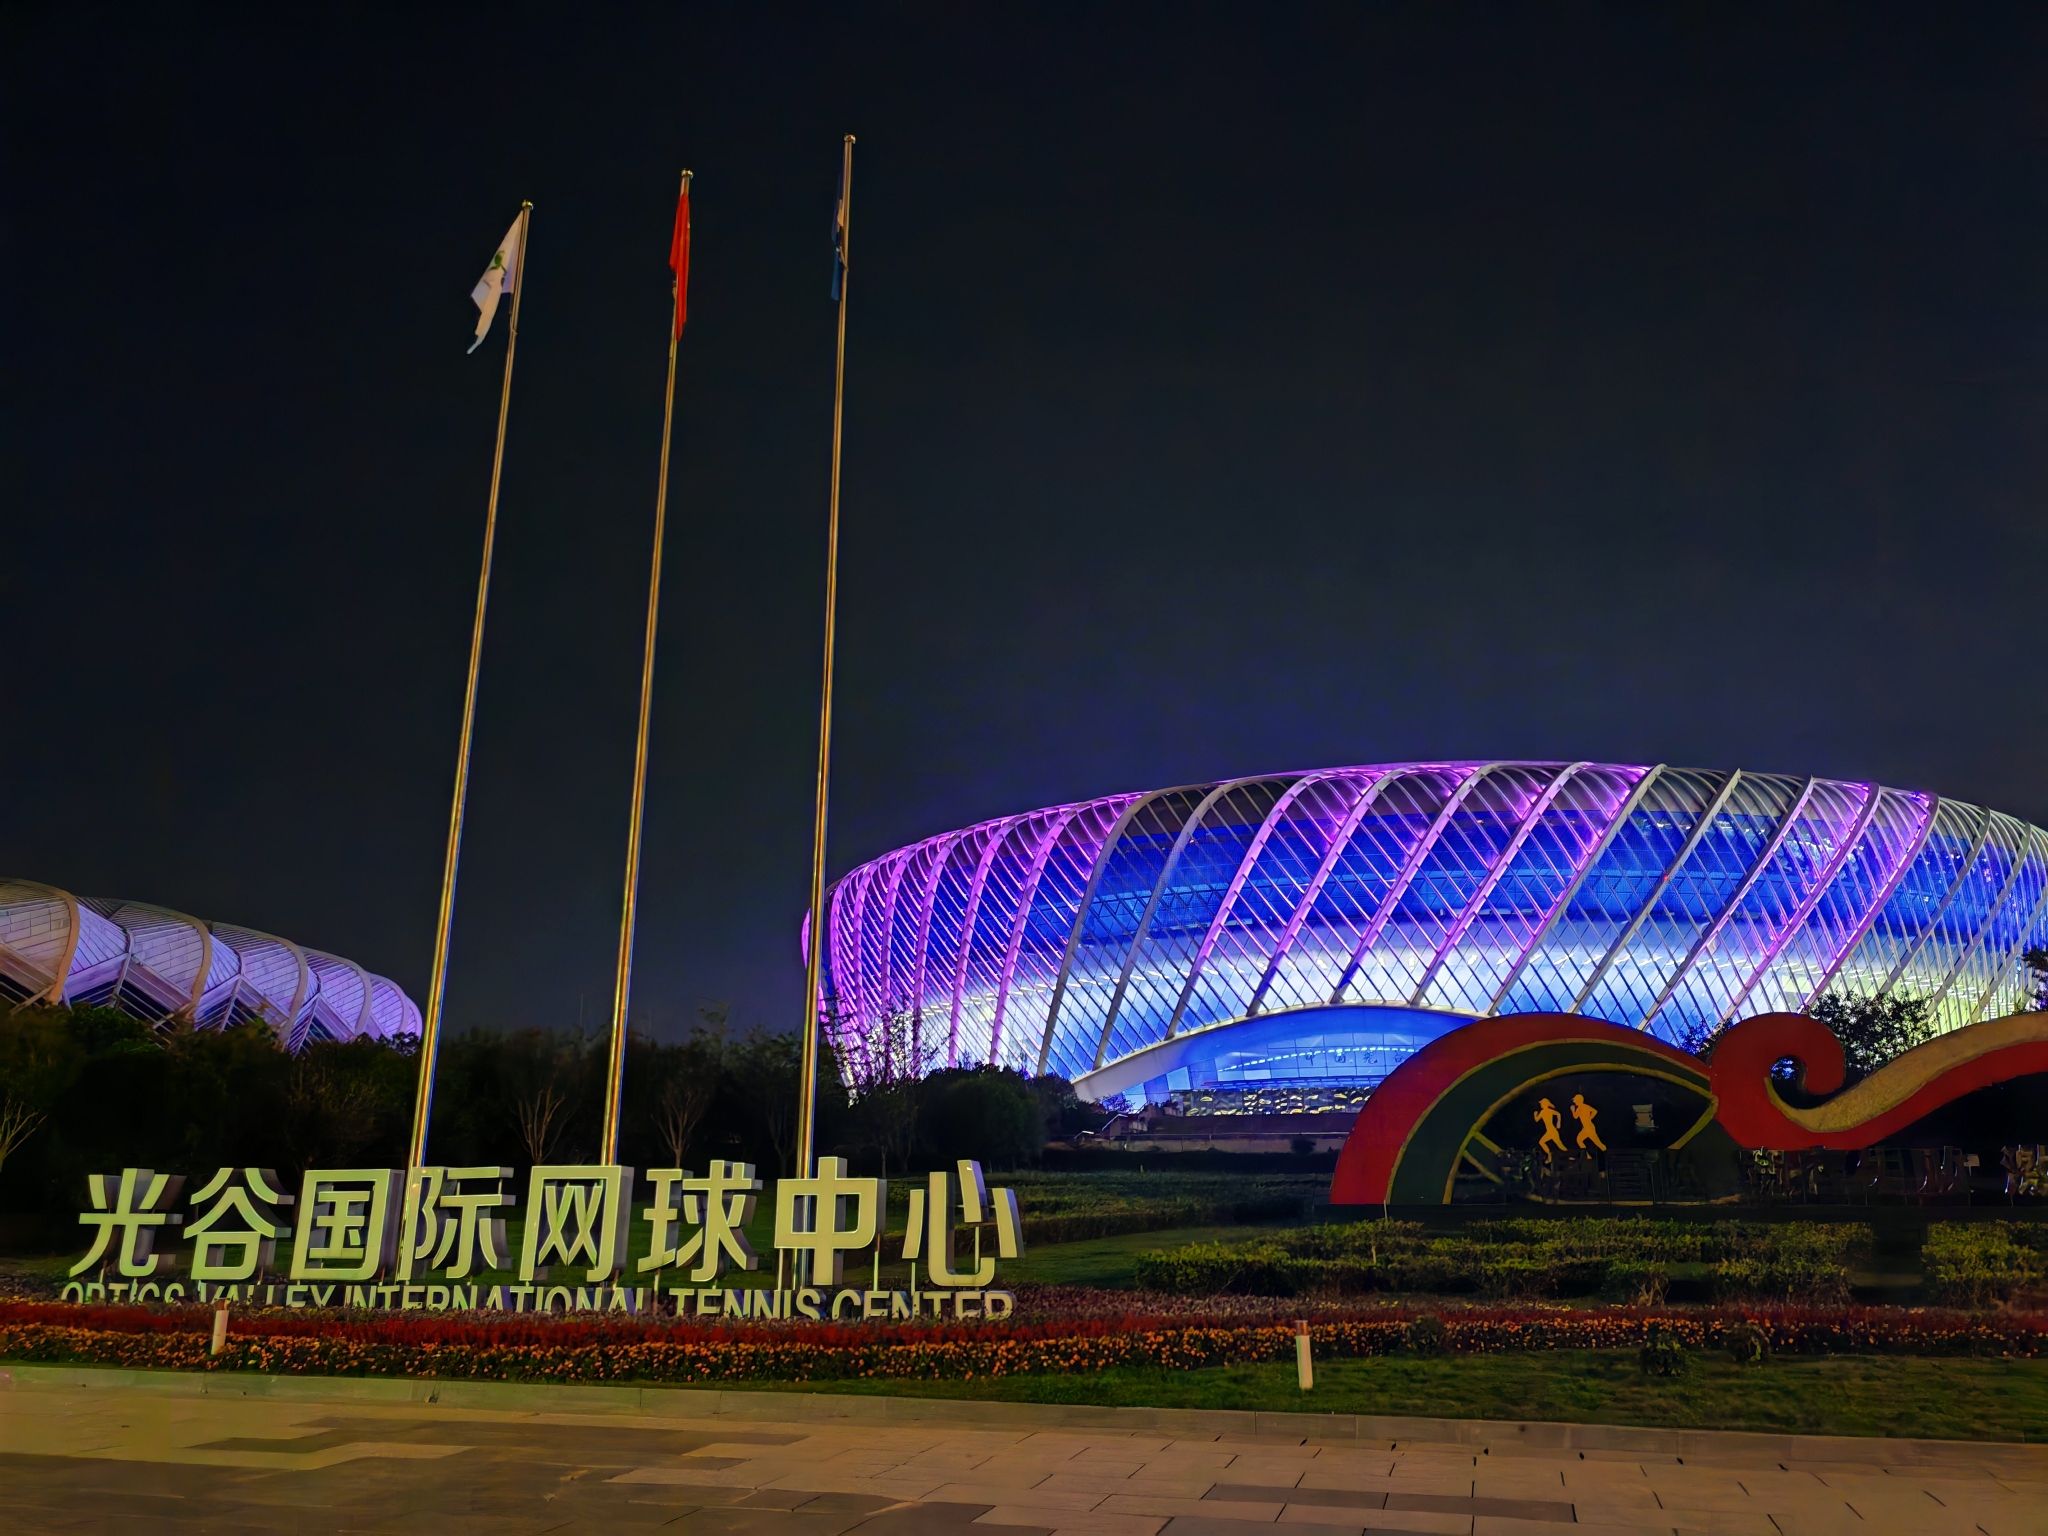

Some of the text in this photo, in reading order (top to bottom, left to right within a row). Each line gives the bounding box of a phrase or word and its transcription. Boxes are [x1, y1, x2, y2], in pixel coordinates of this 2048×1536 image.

[68, 1156, 1022, 1287] 光谷国际网球中心
[668, 1288, 821, 1320] TENNIS
[832, 1289, 1014, 1321] CENTER
